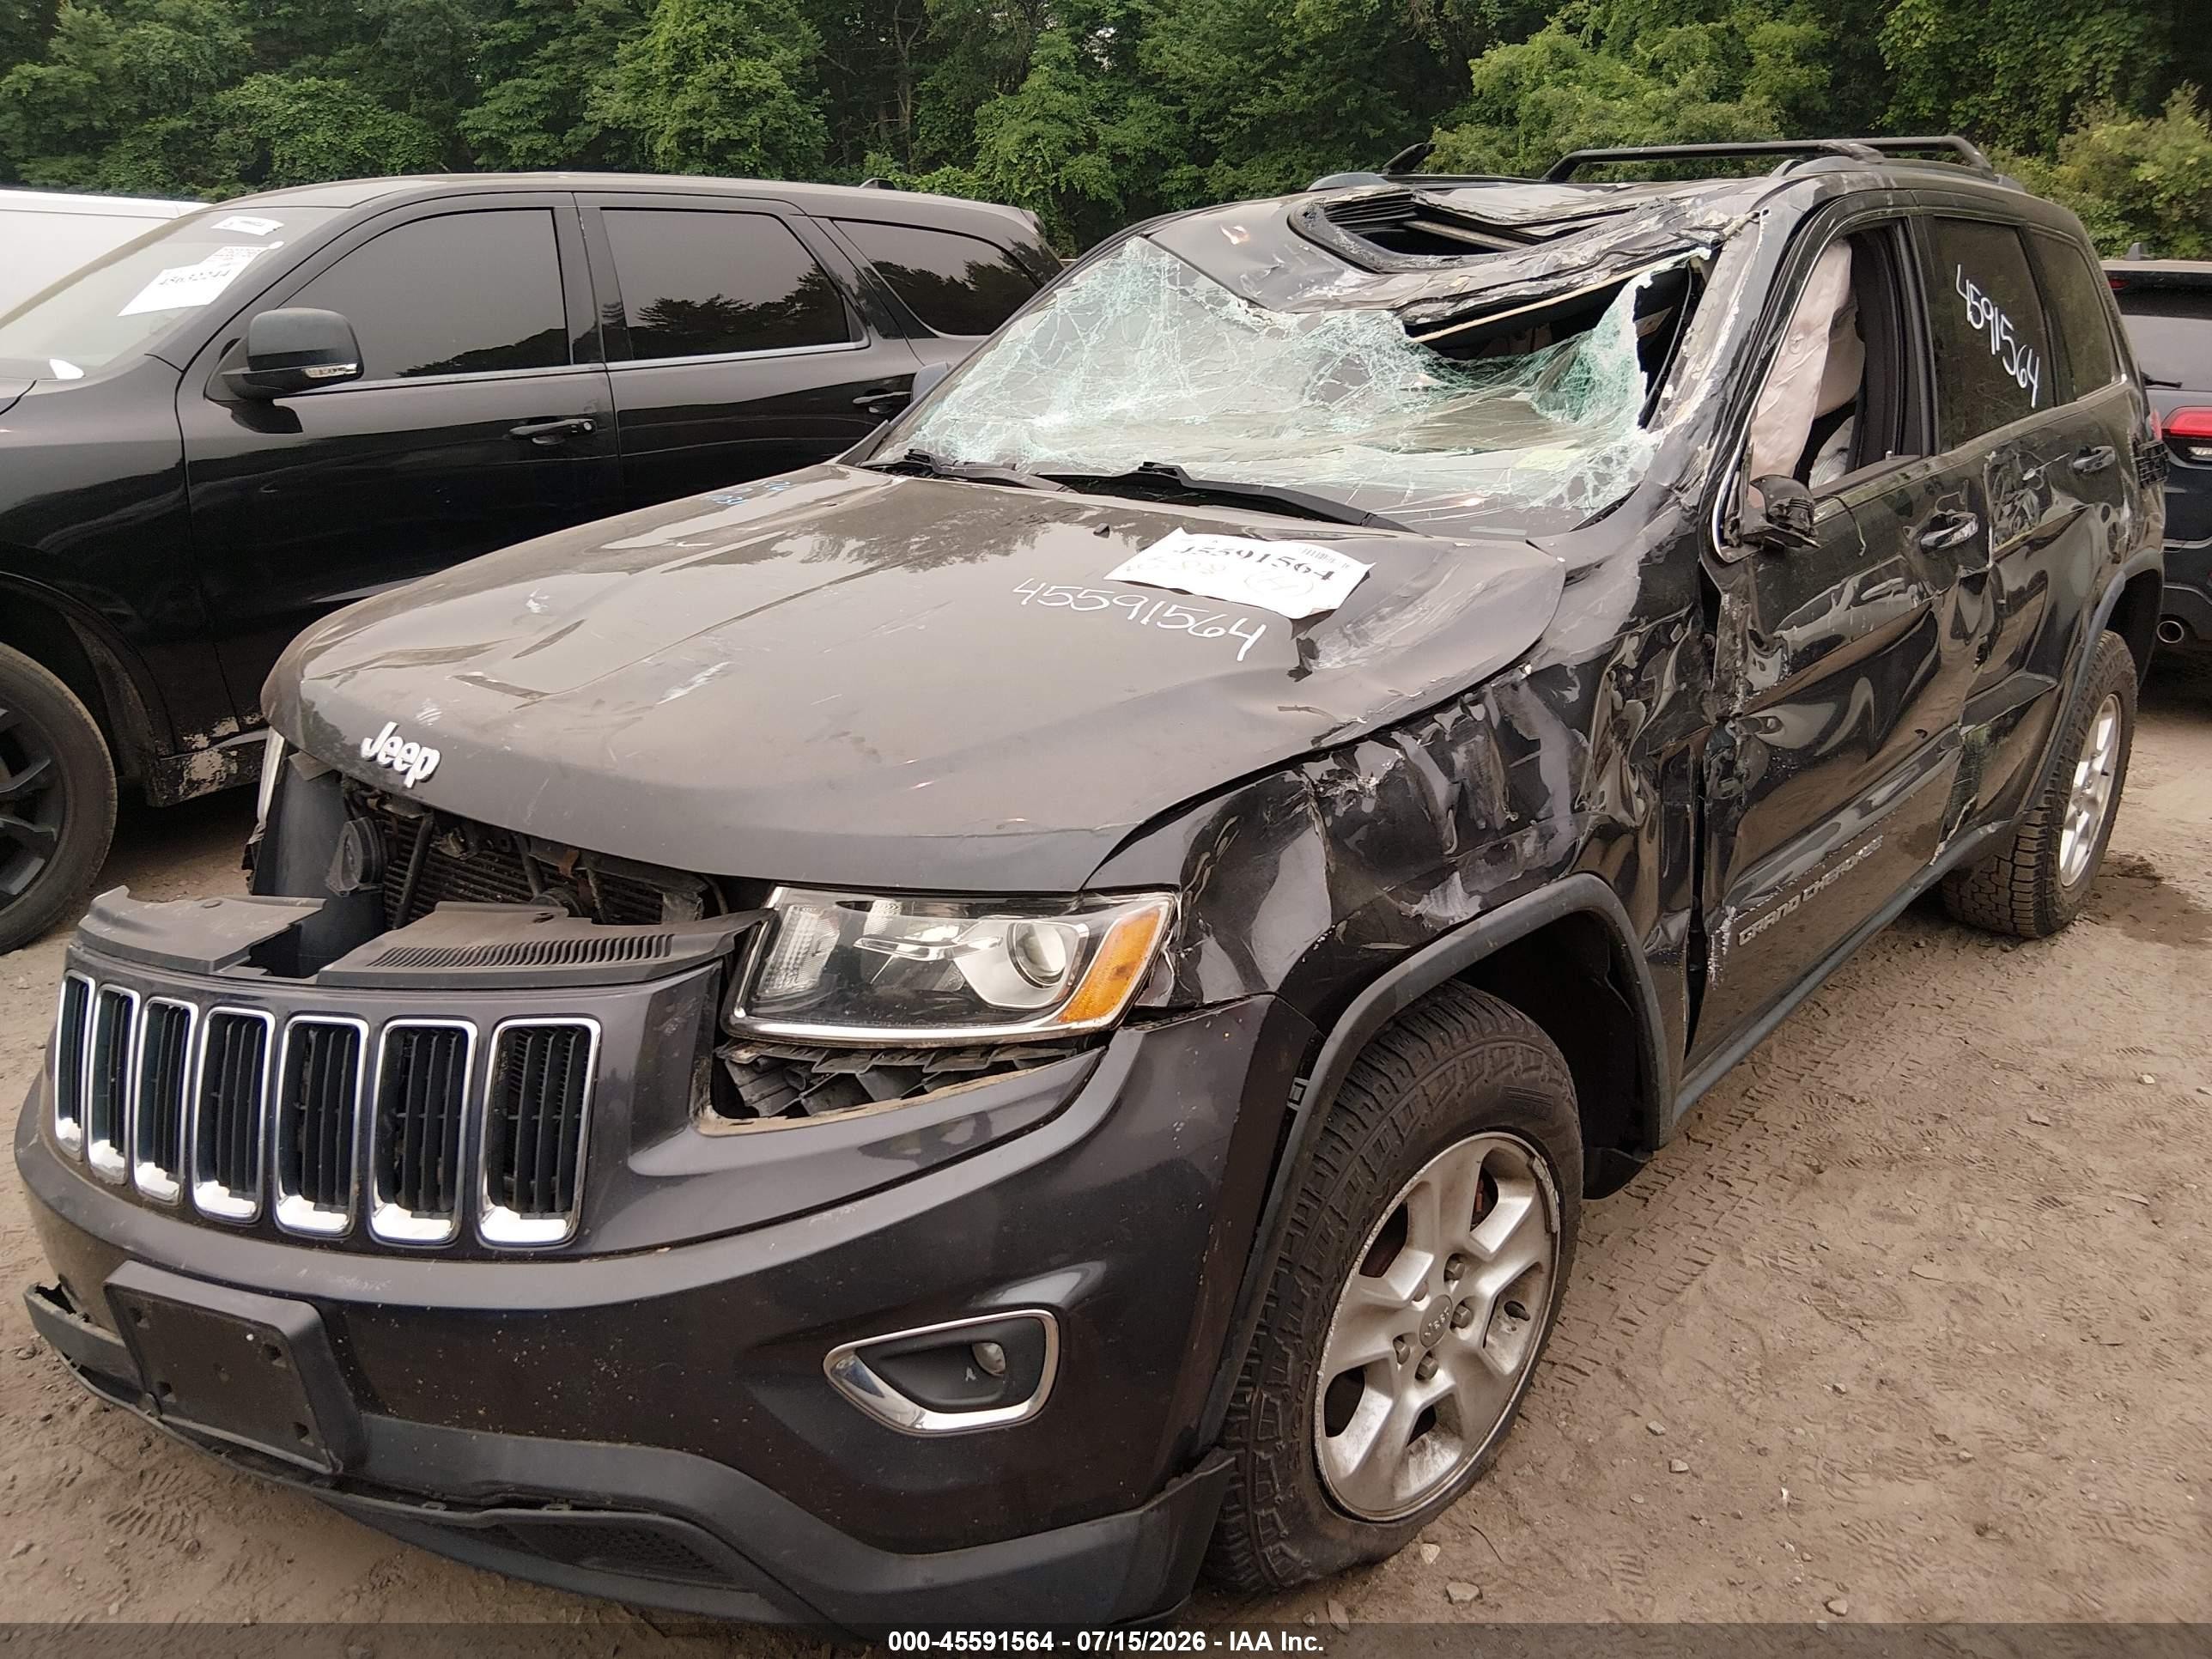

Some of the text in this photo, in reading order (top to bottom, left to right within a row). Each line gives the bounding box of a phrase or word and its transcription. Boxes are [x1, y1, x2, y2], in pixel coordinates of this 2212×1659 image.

[1012, 578, 1267, 661] 45591564
[360, 721, 441, 788] Jeep
[1739, 895, 1802, 946] GRAND
